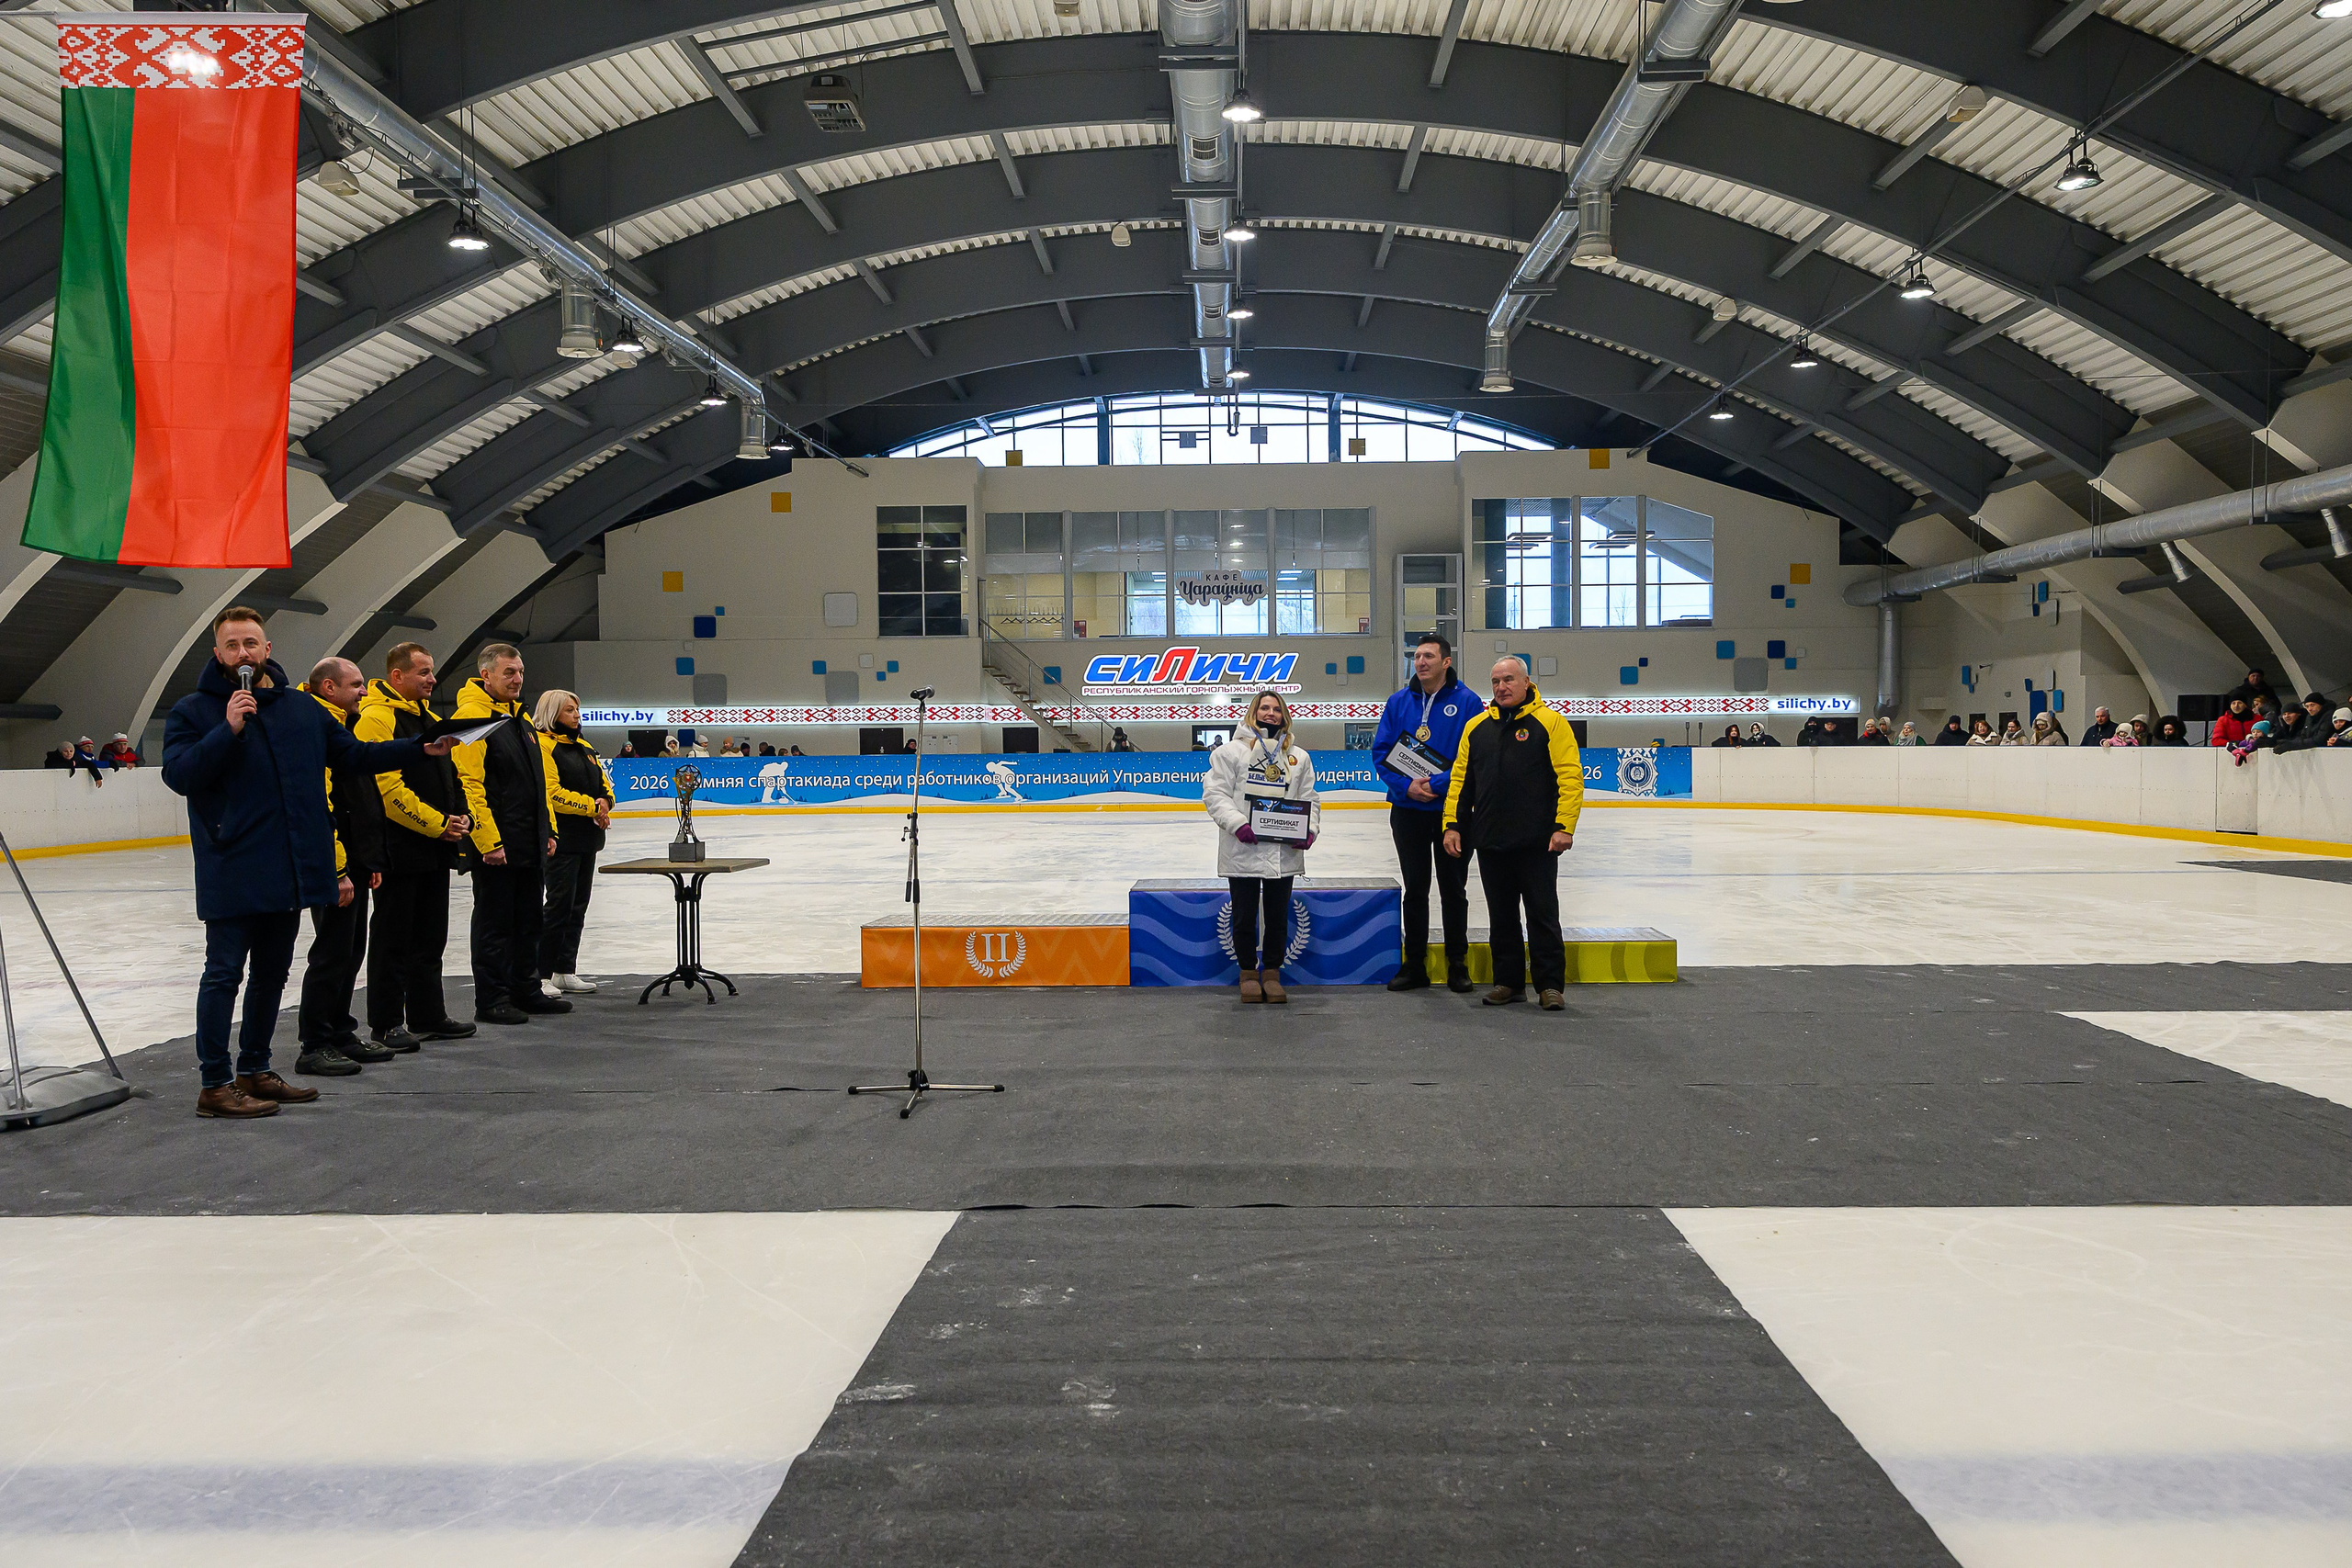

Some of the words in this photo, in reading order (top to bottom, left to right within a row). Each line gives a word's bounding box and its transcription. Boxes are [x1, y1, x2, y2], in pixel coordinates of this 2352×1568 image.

[1205, 573, 1238, 581] КАФЕ
[1083, 684, 1184, 694] РЕСПУБЛИКАНСКИЙ
[1186, 684, 1266, 694] ГОРНОЛЫЖНЫЙ
[1777, 697, 1852, 711] silichy.by
[582, 710, 654, 724] silichy.by
[629, 775, 669, 790] 2026
[699, 776, 744, 789] мняя
[748, 775, 851, 791] спартакиада
[854, 773, 902, 790] среди
[907, 770, 1001, 790] работников
[1004, 769, 1109, 788] организаций
[1113, 769, 1206, 787] Управления
[1316, 770, 1372, 784] идента
[552, 795, 589, 810] BELARUS
[392, 798, 429, 827] BELARUS
[1260, 818, 1300, 827] СЕРТИФИКАТ
[981, 932, 1011, 963] II
